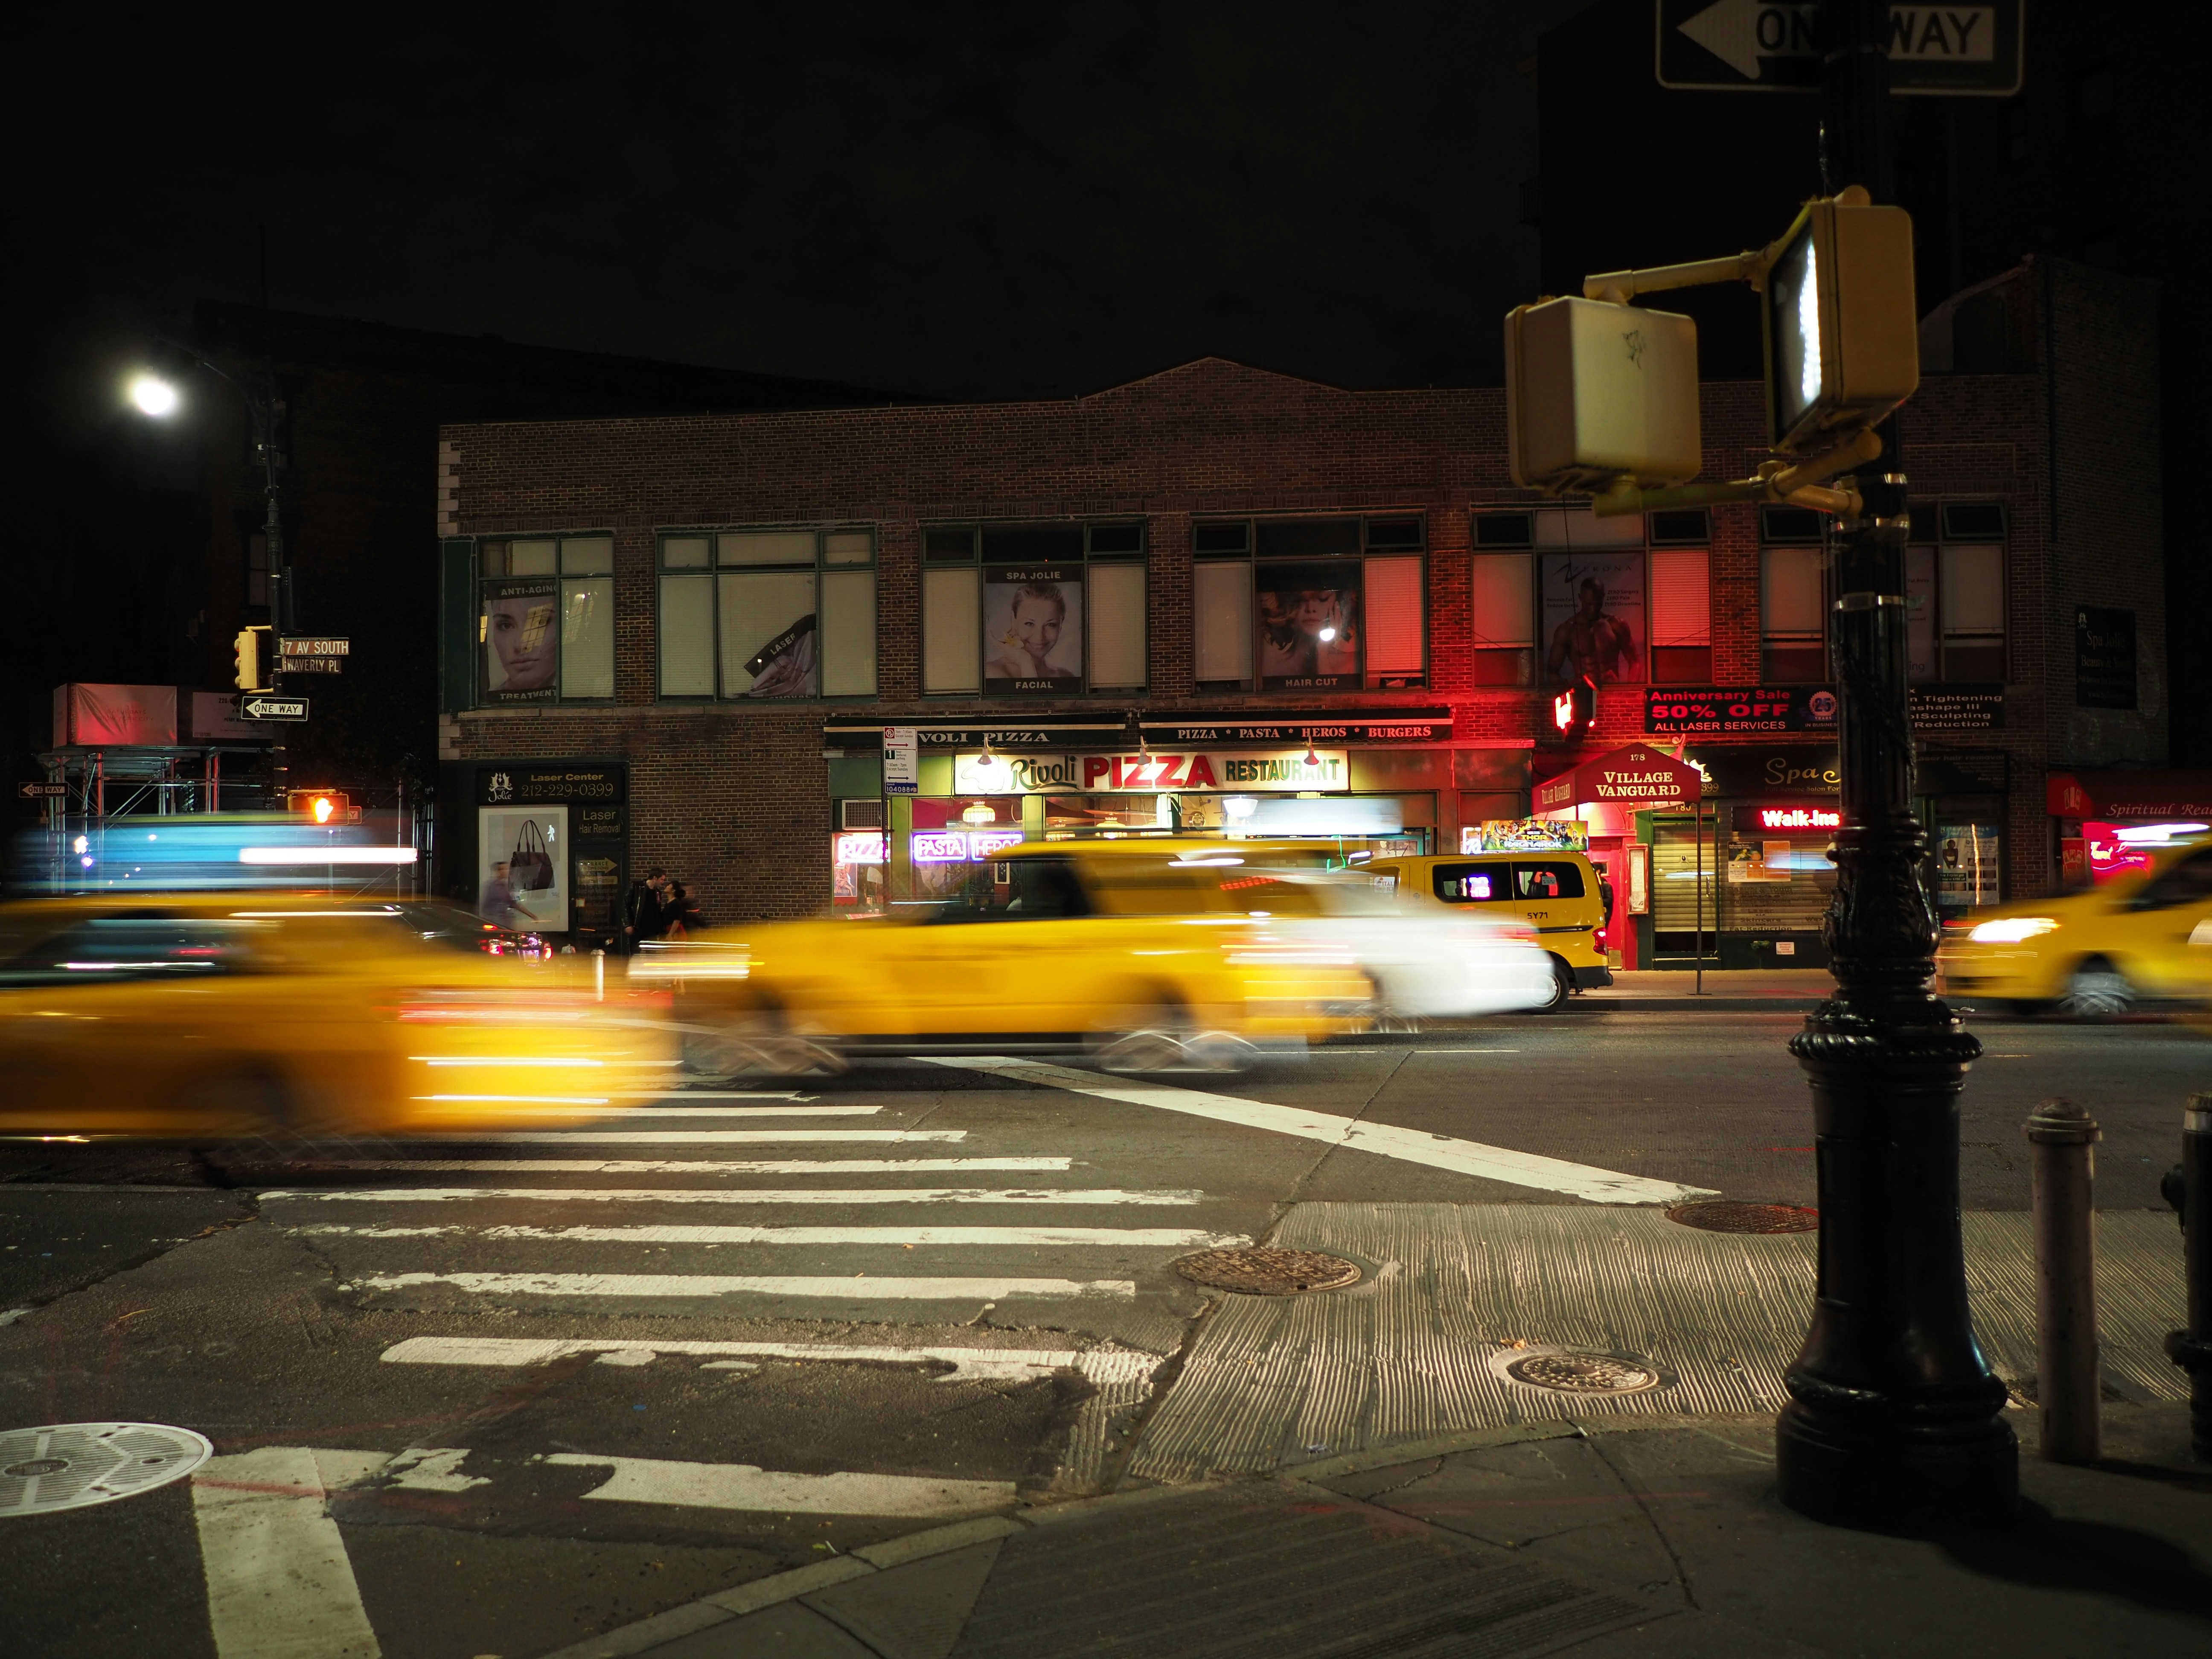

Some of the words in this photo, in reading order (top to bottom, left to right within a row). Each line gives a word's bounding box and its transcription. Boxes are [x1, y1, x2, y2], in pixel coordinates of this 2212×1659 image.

[1757, 9, 1819, 51] ON
[1889, 12, 1980, 54] WAY
[2087, 631, 2103, 650] Spa
[285, 642, 293, 653] 7
[297, 642, 310, 654] AV
[314, 641, 349, 653] SOUTH
[287, 659, 325, 672] WAVERLY
[329, 660, 339, 672] PL
[1286, 679, 1312, 687] HAIR
[1316, 678, 1338, 686] CUT
[1650, 691, 1749, 701] Anniversary
[1755, 690, 1790, 699] Sale
[1923, 695, 2002, 703] Tightening
[255, 704, 274, 713] ONE
[279, 705, 299, 713] WAY
[1815, 697, 1831, 712] 25
[1652, 704, 1716, 719] 50%
[1729, 704, 1789, 717] OFF
[1178, 729, 1218, 739] PIZZA
[1239, 728, 1280, 738] PASTA
[1302, 728, 1347, 737] HEROS
[1368, 726, 1432, 737] BURGERS
[1680, 722, 1720, 731] LASER
[1724, 721, 1786, 730] SERVICES
[918, 733, 969, 743] VOLI
[982, 732, 1050, 742] PIZZA
[888, 750, 892, 759] 1
[1010, 755, 1078, 789] Rivoli
[1084, 755, 1217, 788] PIZZA
[1225, 758, 1339, 781] RESTAURANT
[1604, 771, 1673, 783] VILLAGE
[1764, 757, 1819, 785] Spa
[521, 783, 614, 797] 212-229-0399
[1542, 789, 1554, 805] VILLAGE
[1554, 783, 1570, 802] VANGUARD
[1596, 784, 1680, 797] VANGUARD
[583, 810, 616, 820] Laser
[2106, 803, 2175, 818] Spiritual
[579, 824, 591, 833] Hair
[594, 823, 620, 833] Removal
[918, 839, 963, 856] PASTA
[1504, 840, 1563, 848] RAGNAROK
